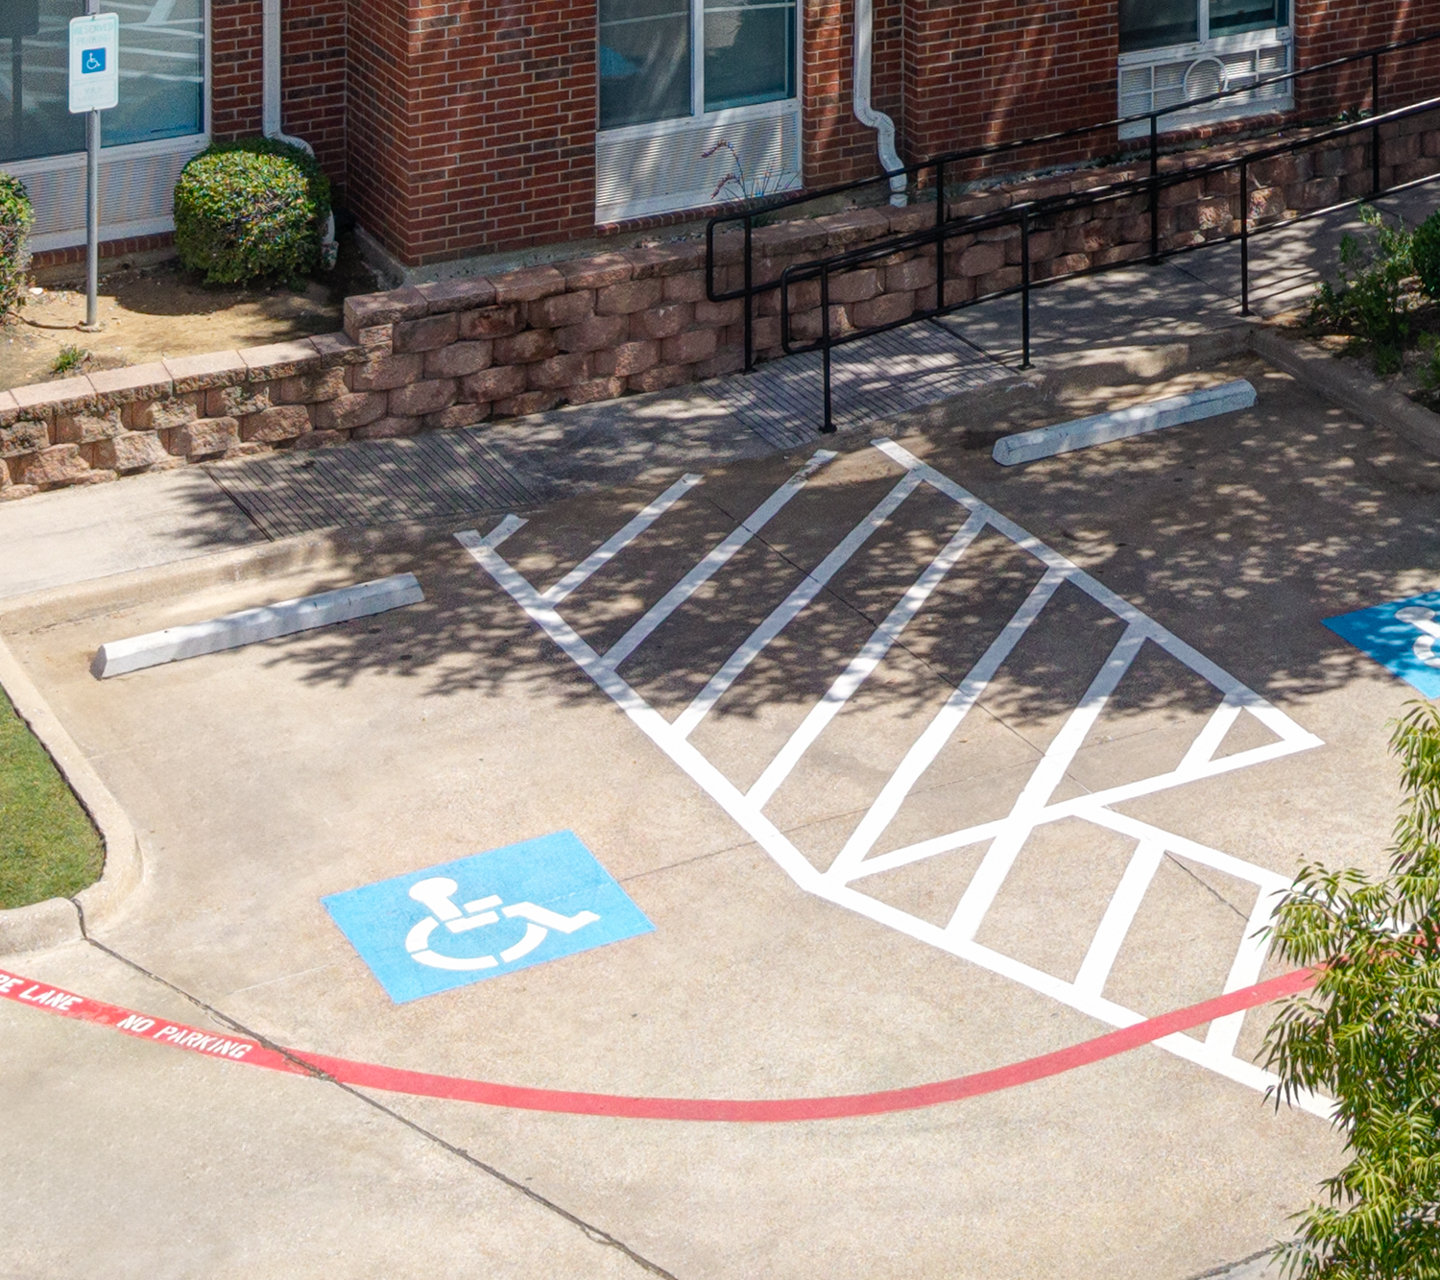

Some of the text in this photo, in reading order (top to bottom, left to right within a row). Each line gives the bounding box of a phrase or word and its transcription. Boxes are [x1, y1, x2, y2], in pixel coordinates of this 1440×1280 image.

[19, 984, 83, 1010] LANE
[116, 1014, 155, 1032] NO
[153, 1025, 253, 1058] PARKING
